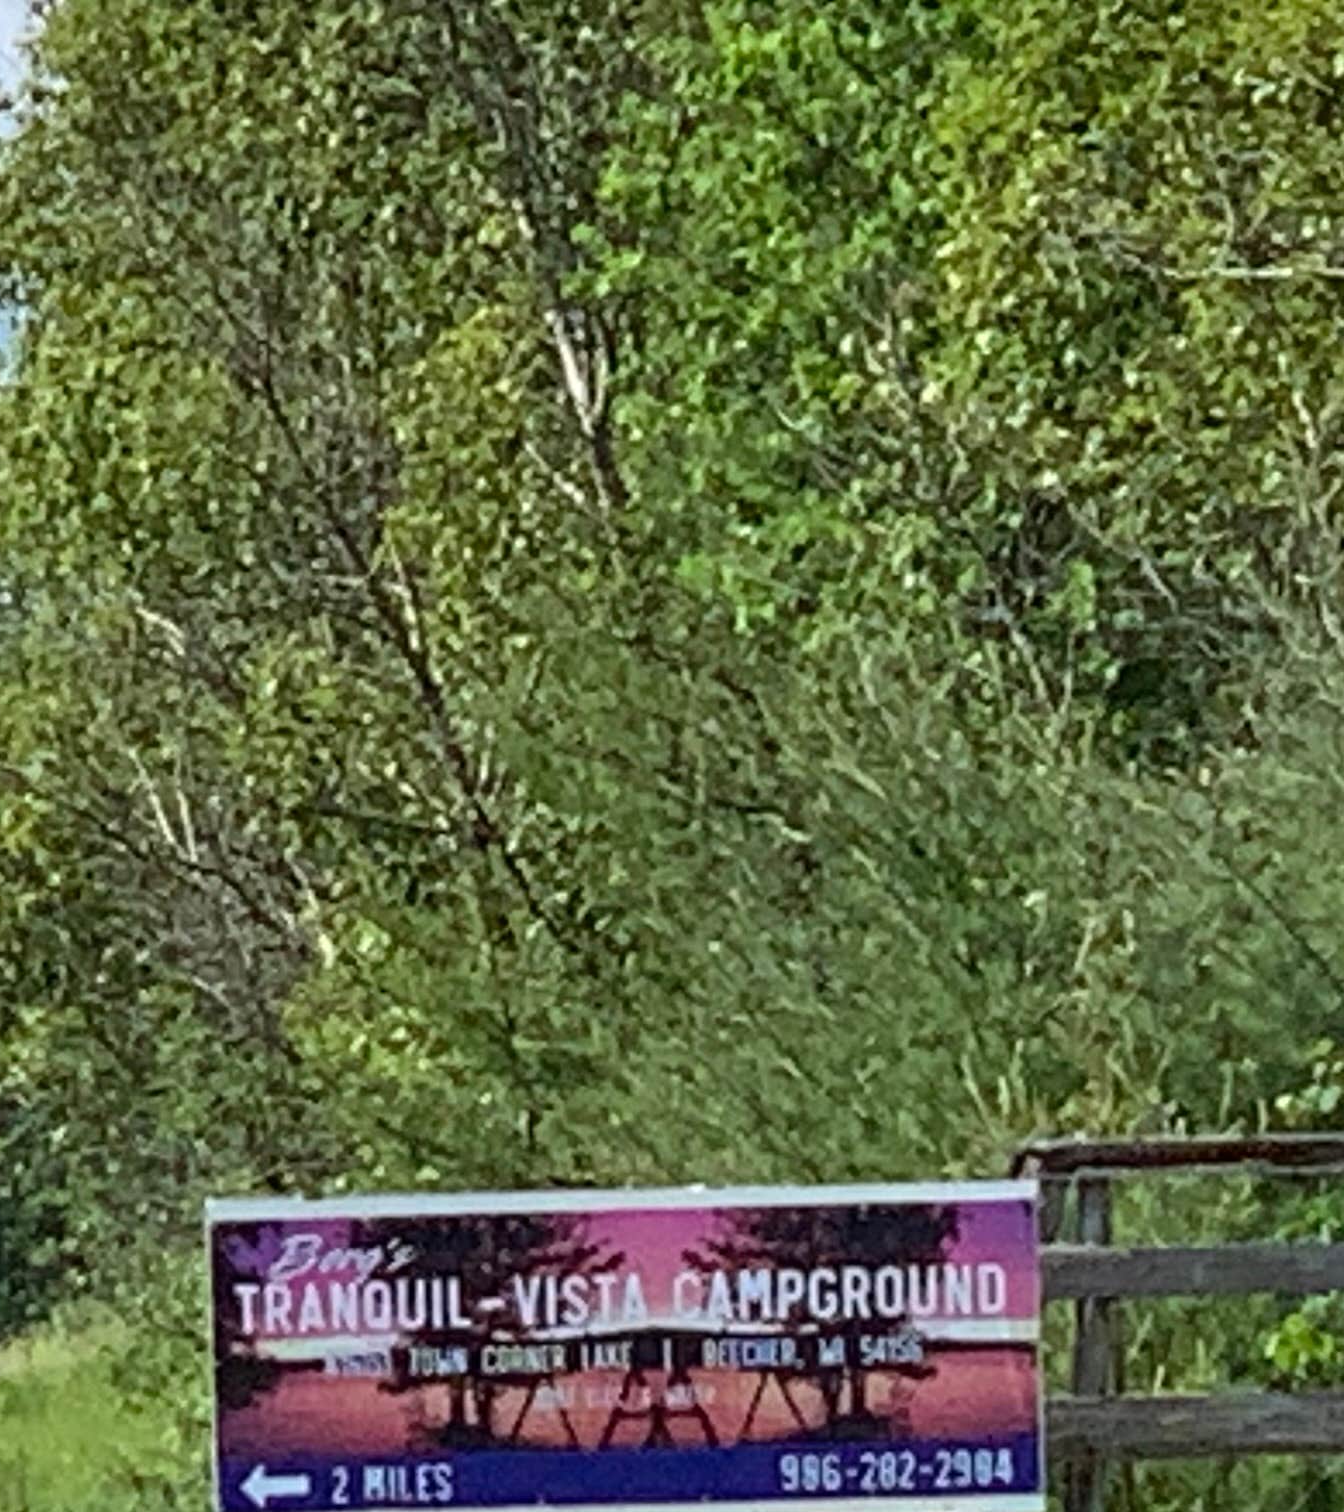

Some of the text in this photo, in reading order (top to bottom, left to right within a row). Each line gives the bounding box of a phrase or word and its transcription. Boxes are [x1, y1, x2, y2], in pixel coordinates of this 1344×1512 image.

[672, 1263, 1007, 1322] CAMPGROUND
[408, 1346, 469, 1376] TOWN
[480, 1344, 567, 1375] CORNER
[580, 1341, 633, 1371] LAKE
[331, 1469, 351, 1505] 2
[363, 1463, 454, 1502] MILES
